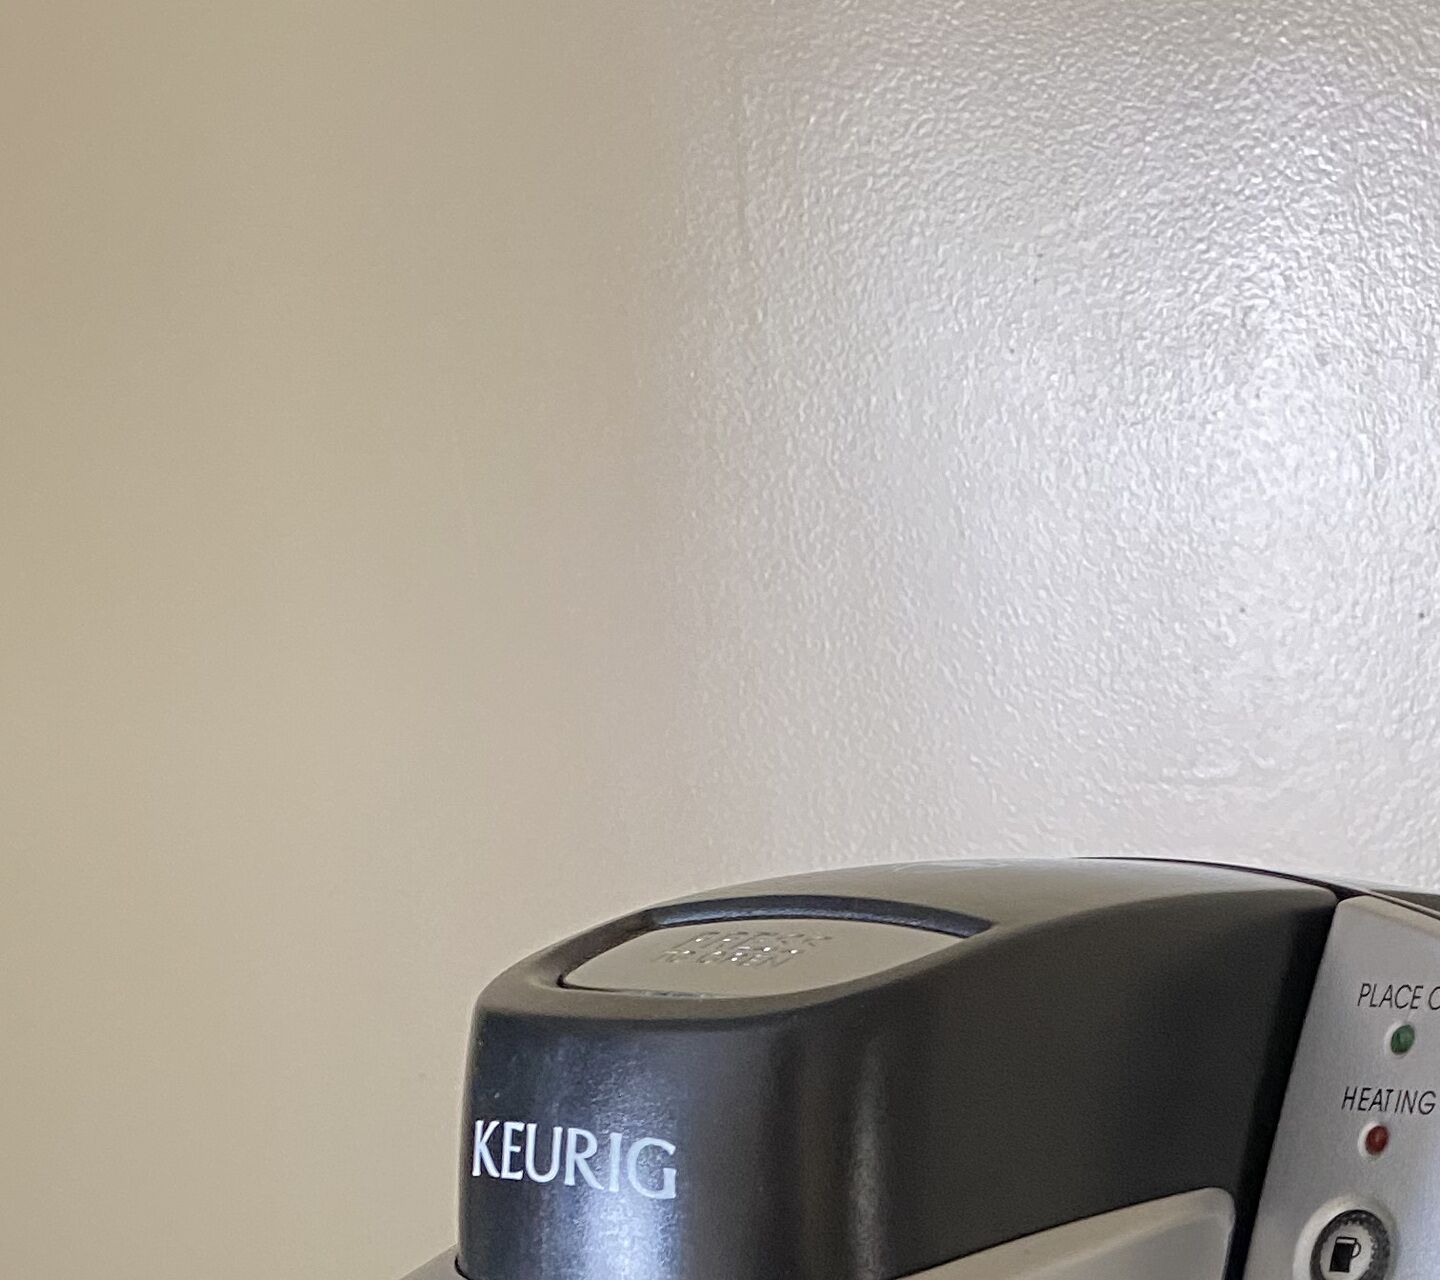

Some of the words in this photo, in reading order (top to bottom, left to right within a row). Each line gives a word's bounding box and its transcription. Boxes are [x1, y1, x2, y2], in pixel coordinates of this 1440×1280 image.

[1357, 983, 1424, 1010] PLACE
[1341, 1086, 1437, 1116] HEATING
[472, 1120, 678, 1200] KEURIG
